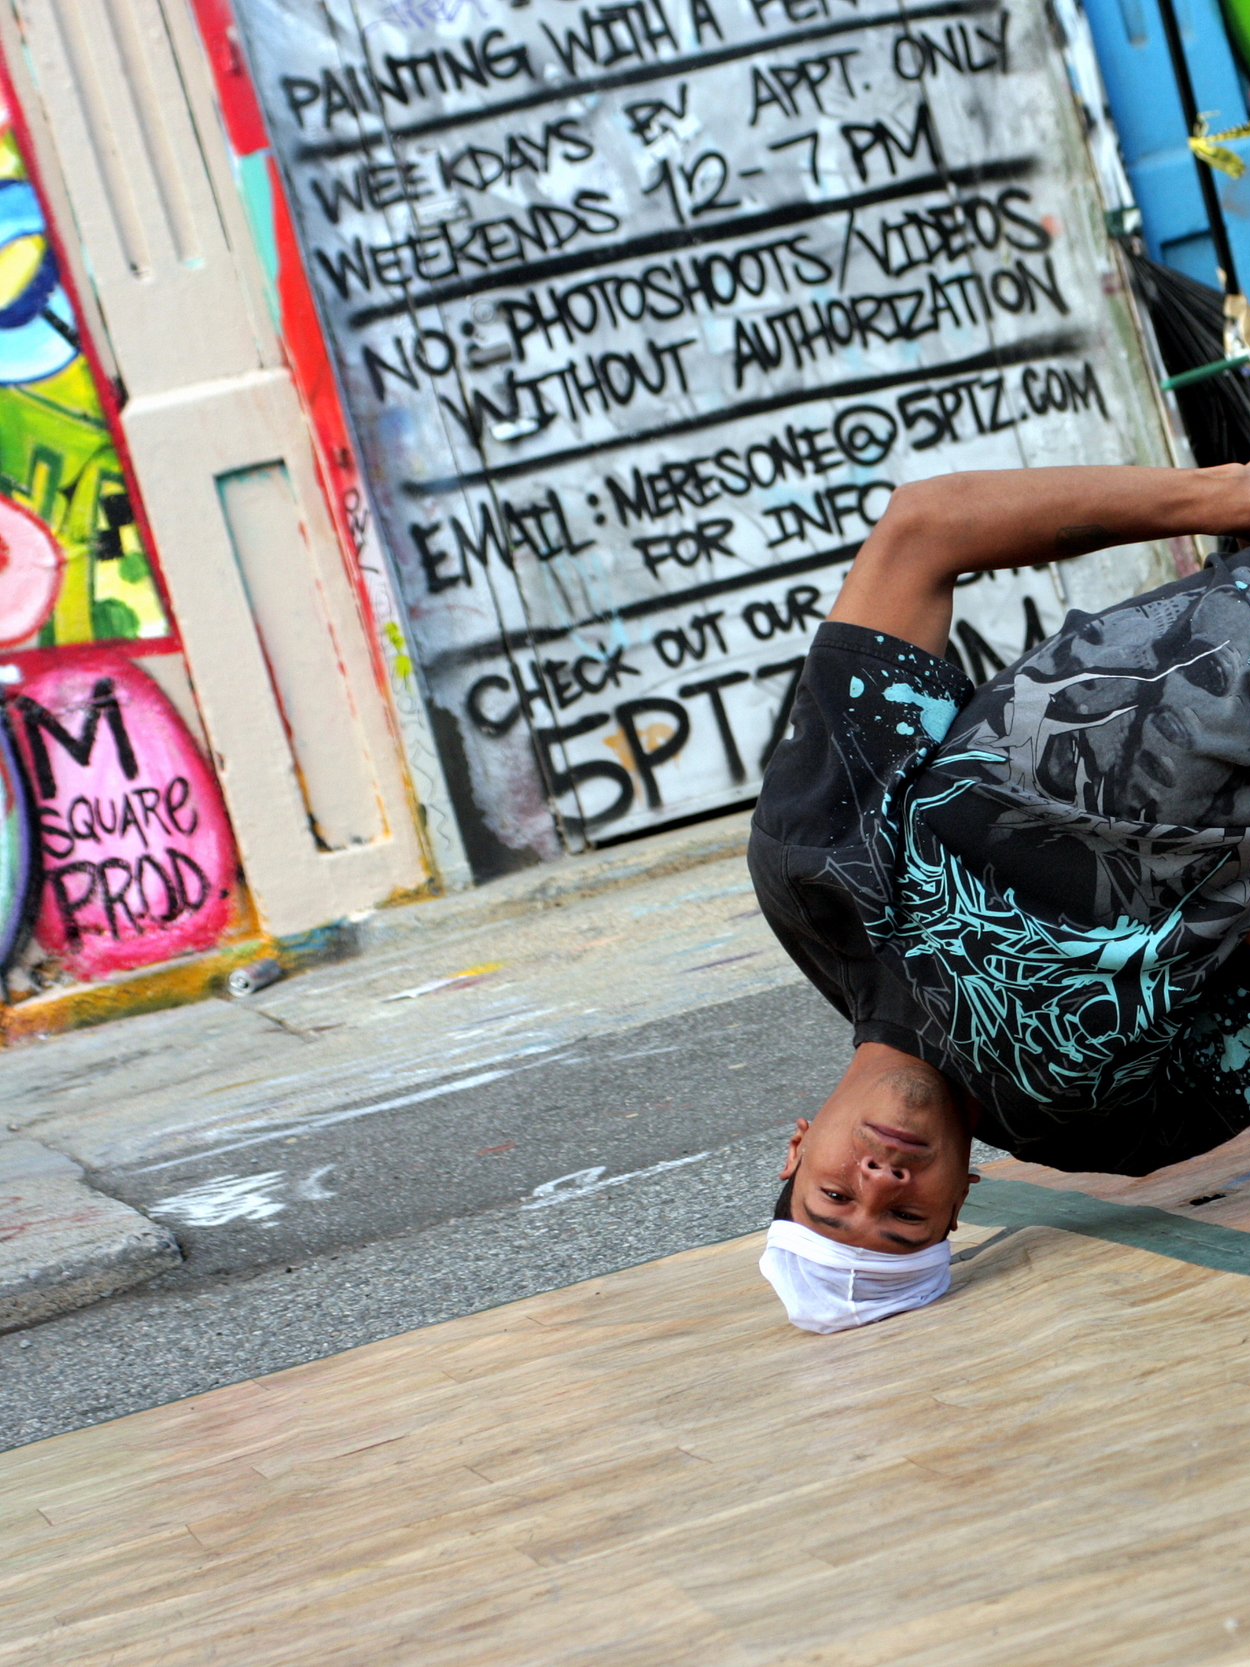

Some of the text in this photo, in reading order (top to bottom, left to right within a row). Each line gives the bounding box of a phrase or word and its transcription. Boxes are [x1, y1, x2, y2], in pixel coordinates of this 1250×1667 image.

[280, 29, 536, 130] PAINTING
[540, 1, 679, 76] WITH
[310, 118, 595, 225] WEEKDAYS
[749, 49, 874, 127] APPT.
[891, 11, 1009, 82] ONLY
[315, 190, 620, 300] WEEKENDS
[841, 103, 947, 182] PM
[437, 257, 1070, 452] WITHOUT AUTHORIZATION
[632, 479, 897, 580] FOR INFO
[465, 584, 828, 739] CHECK OUT OUR
[18, 677, 138, 800] M
[44, 847, 230, 952] PROD.
